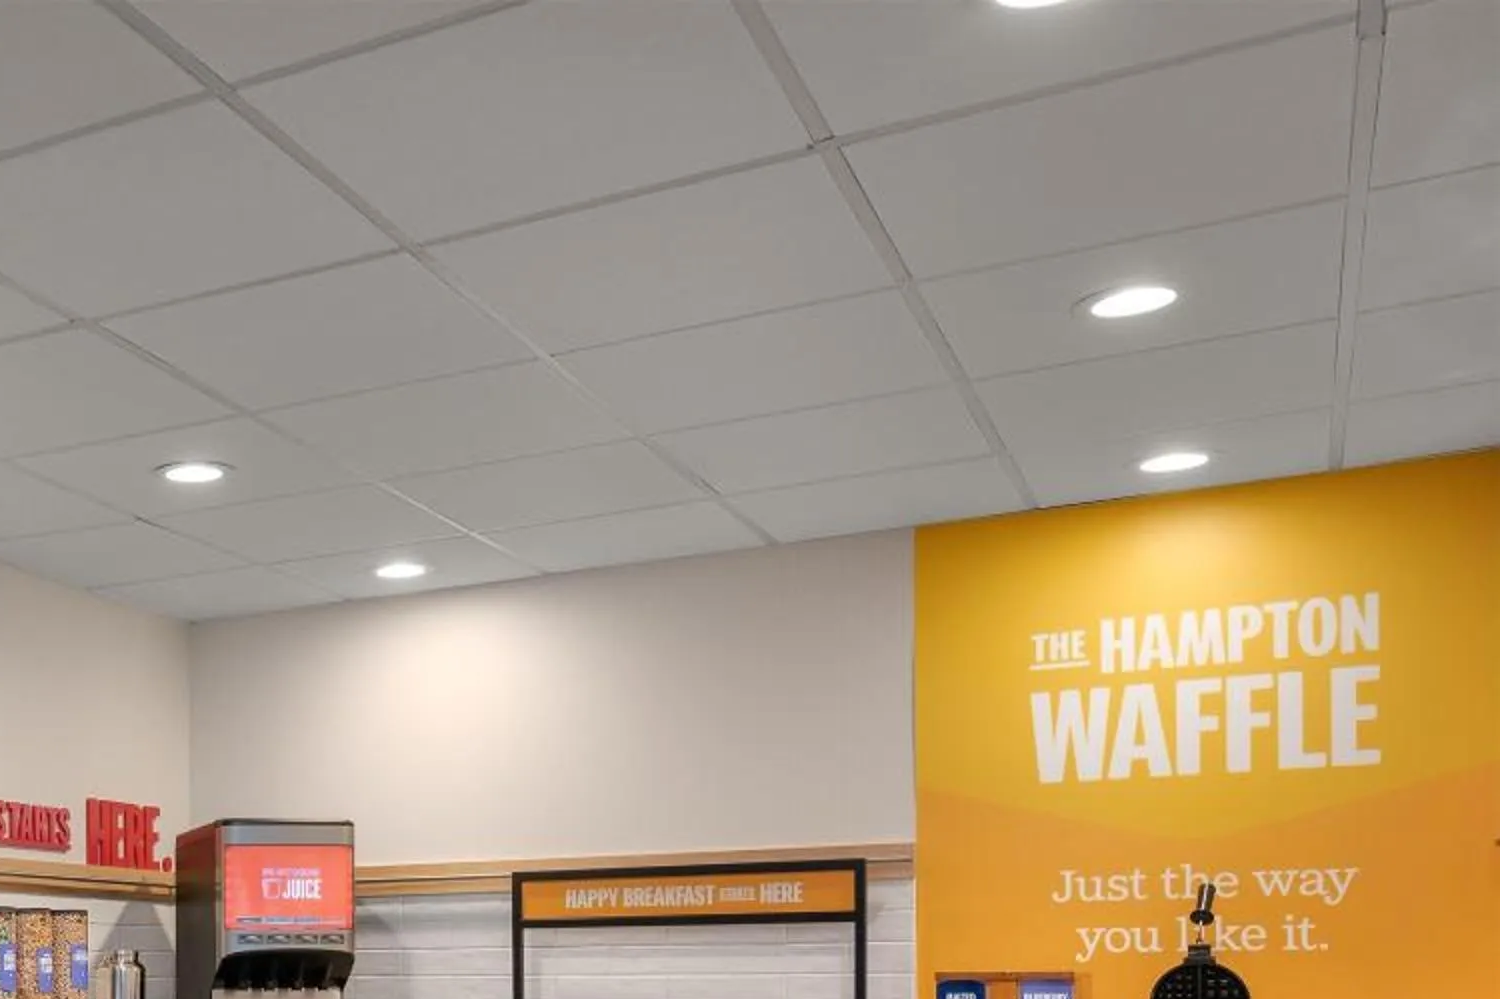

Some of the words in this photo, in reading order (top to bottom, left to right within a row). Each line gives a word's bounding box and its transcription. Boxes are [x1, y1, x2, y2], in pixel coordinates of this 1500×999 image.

[1030, 630, 1091, 671] THE
[1100, 592, 1380, 673] HAMPTON
[1029, 664, 1382, 783] WAFFLE
[85, 798, 173, 872] HERE.
[281, 878, 323, 900] JUICE
[565, 887, 619, 909] HAPPY
[622, 884, 716, 908] BREAKFAST
[760, 881, 805, 905] HERE
[1052, 867, 1148, 902] Just
[1161, 863, 1239, 899] the
[1251, 866, 1360, 906] way
[1074, 926, 1164, 963] you
[1175, 914, 1268, 952] lke
[1283, 914, 1329, 952] it.
